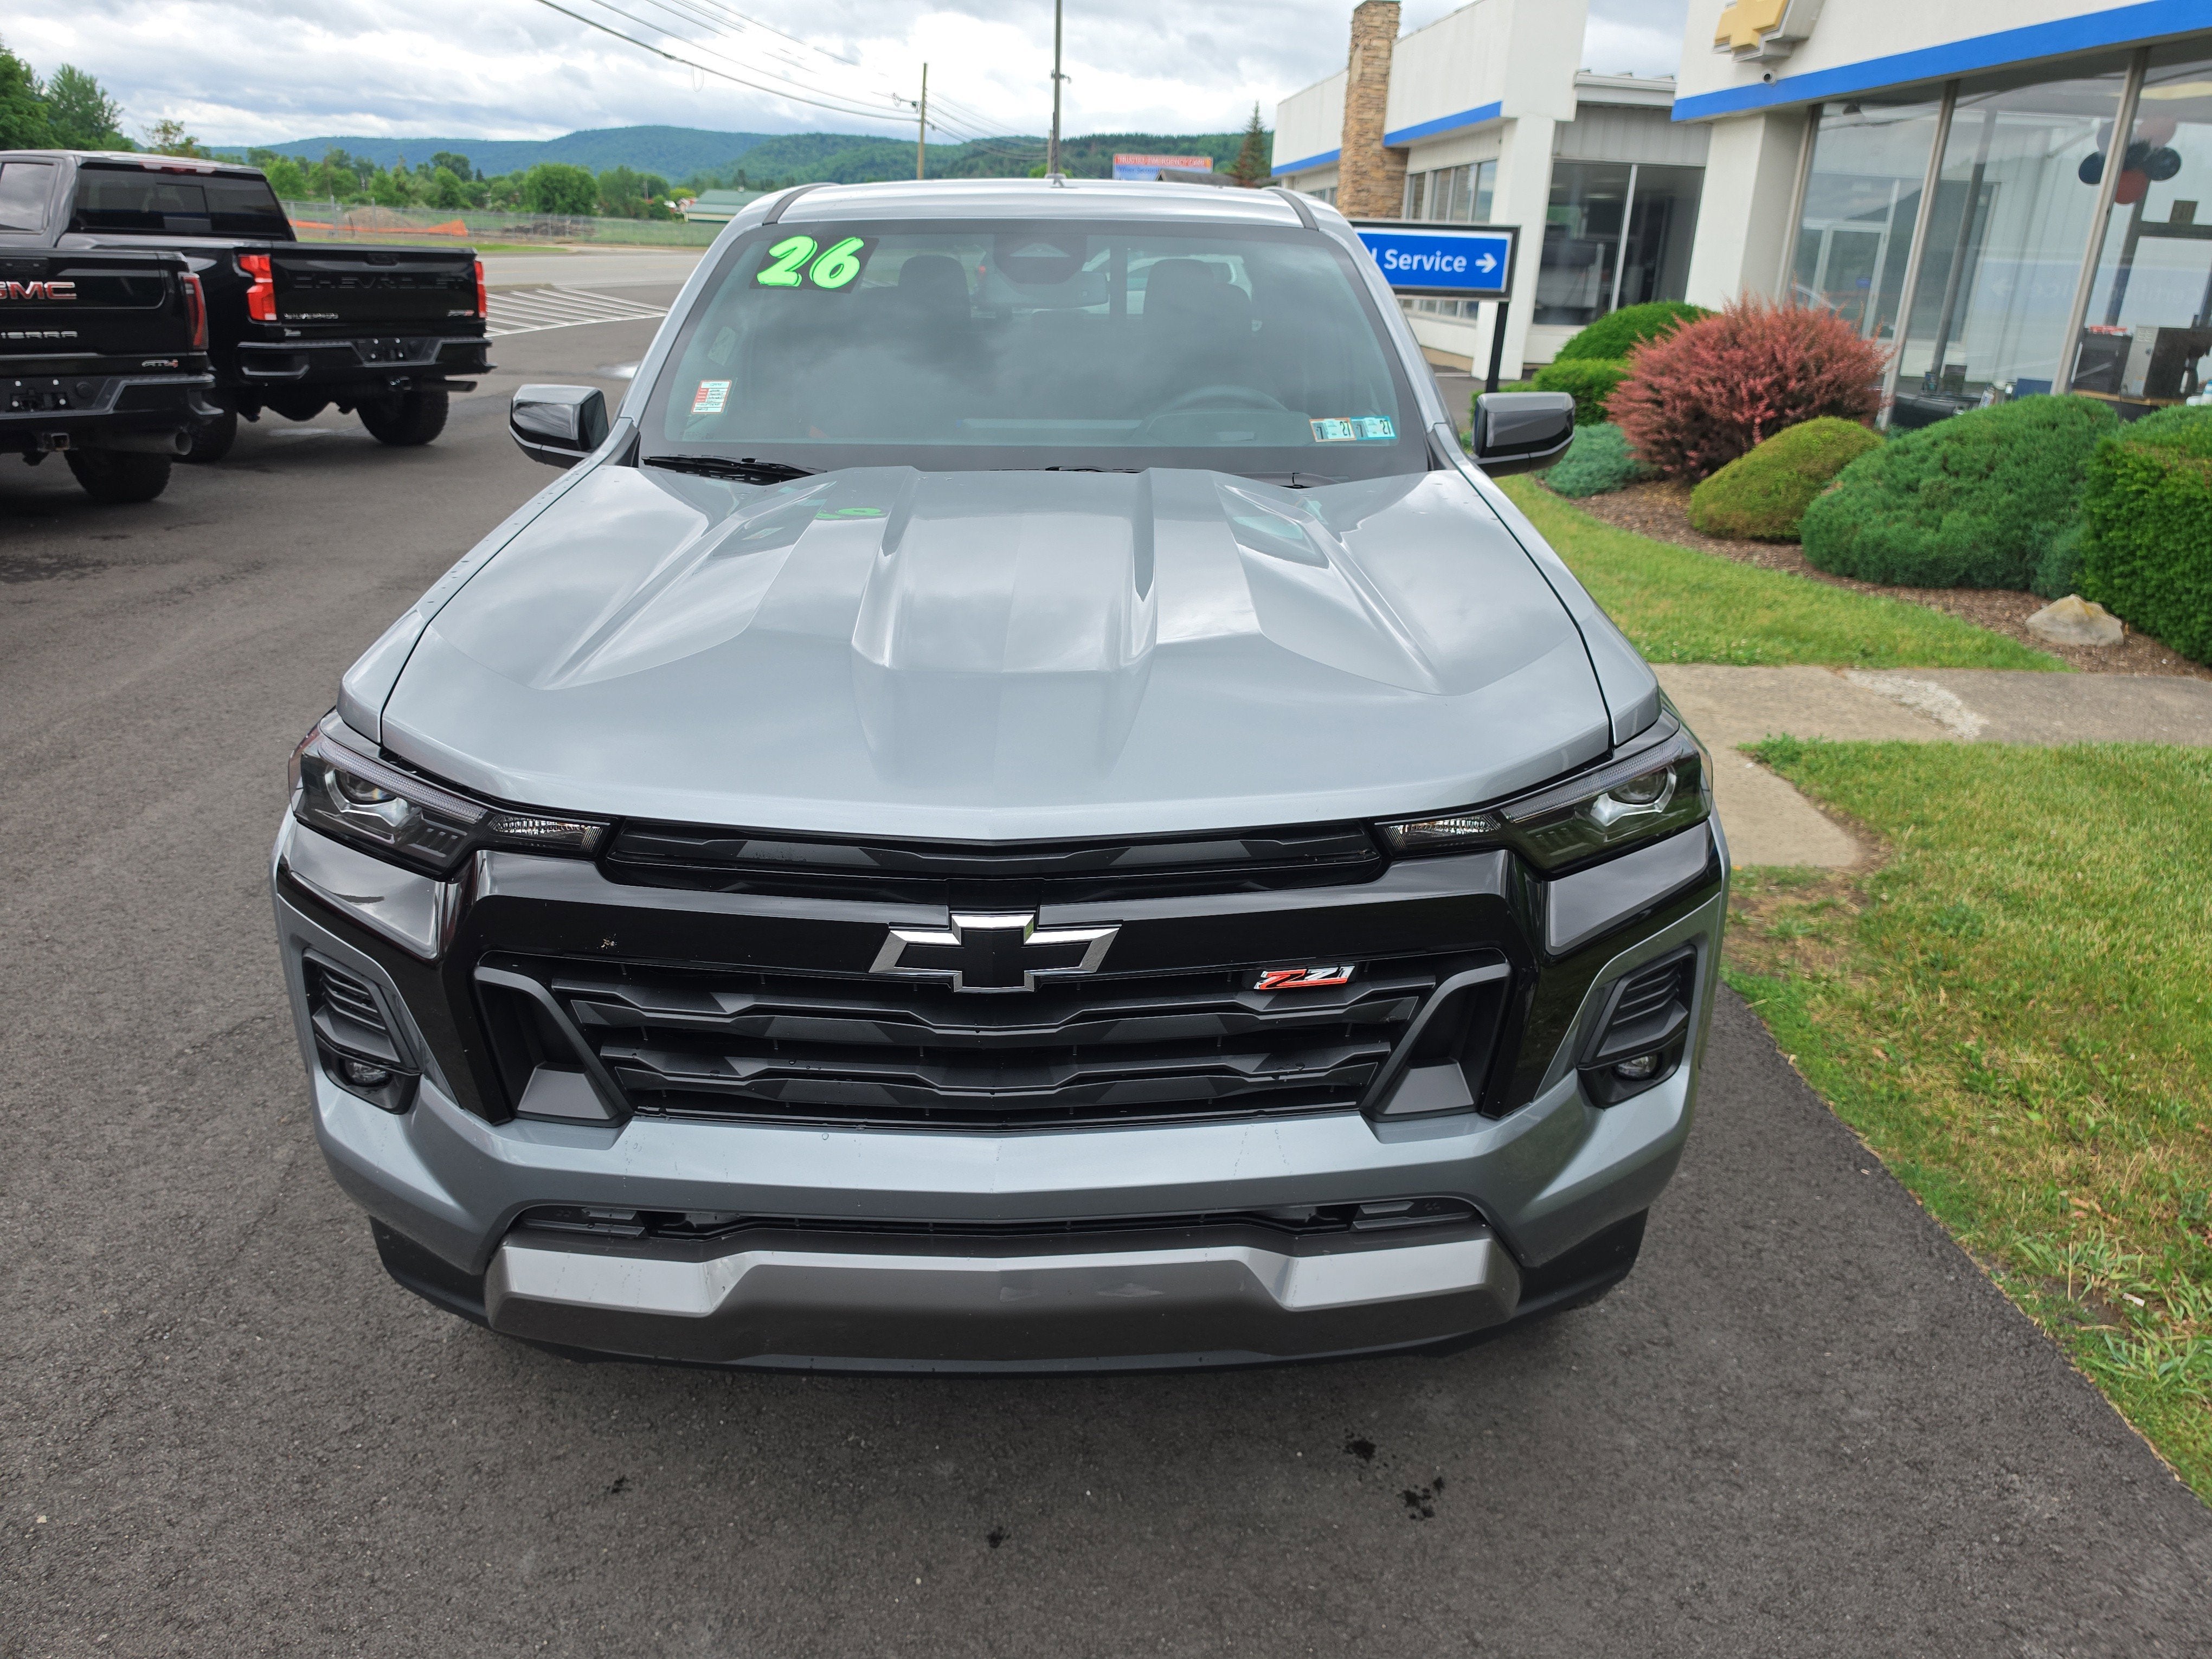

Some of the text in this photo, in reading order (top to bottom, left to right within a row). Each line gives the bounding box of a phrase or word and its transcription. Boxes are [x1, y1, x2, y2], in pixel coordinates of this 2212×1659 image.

[757, 235, 864, 288] 26
[1384, 248, 1467, 273] Service
[294, 276, 464, 289] CHEVROLET
[1253, 966, 1355, 989] Z71
